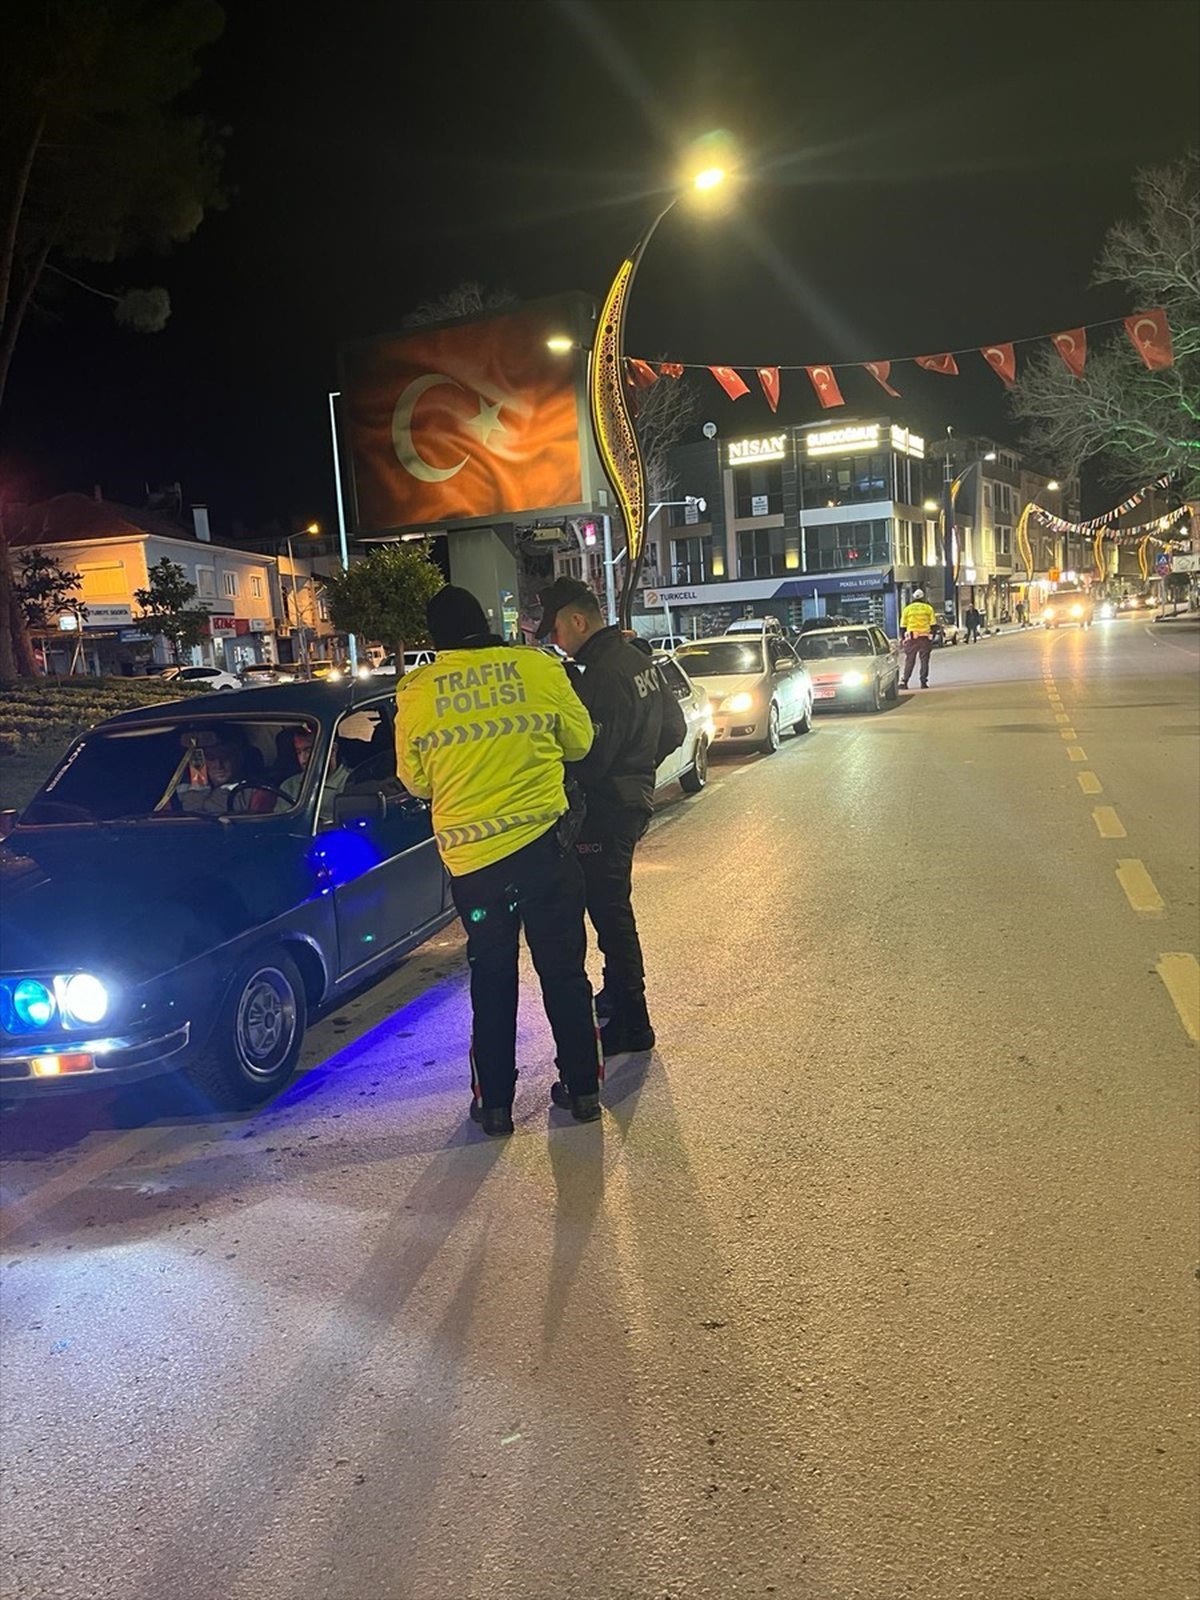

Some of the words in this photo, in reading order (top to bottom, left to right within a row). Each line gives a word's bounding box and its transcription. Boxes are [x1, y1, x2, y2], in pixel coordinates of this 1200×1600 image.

[728, 434, 787, 458] NİSAN
[659, 591, 697, 601] TURKCELL
[433, 660, 522, 694] TRAFİK
[435, 682, 526, 718] POLİSİ
